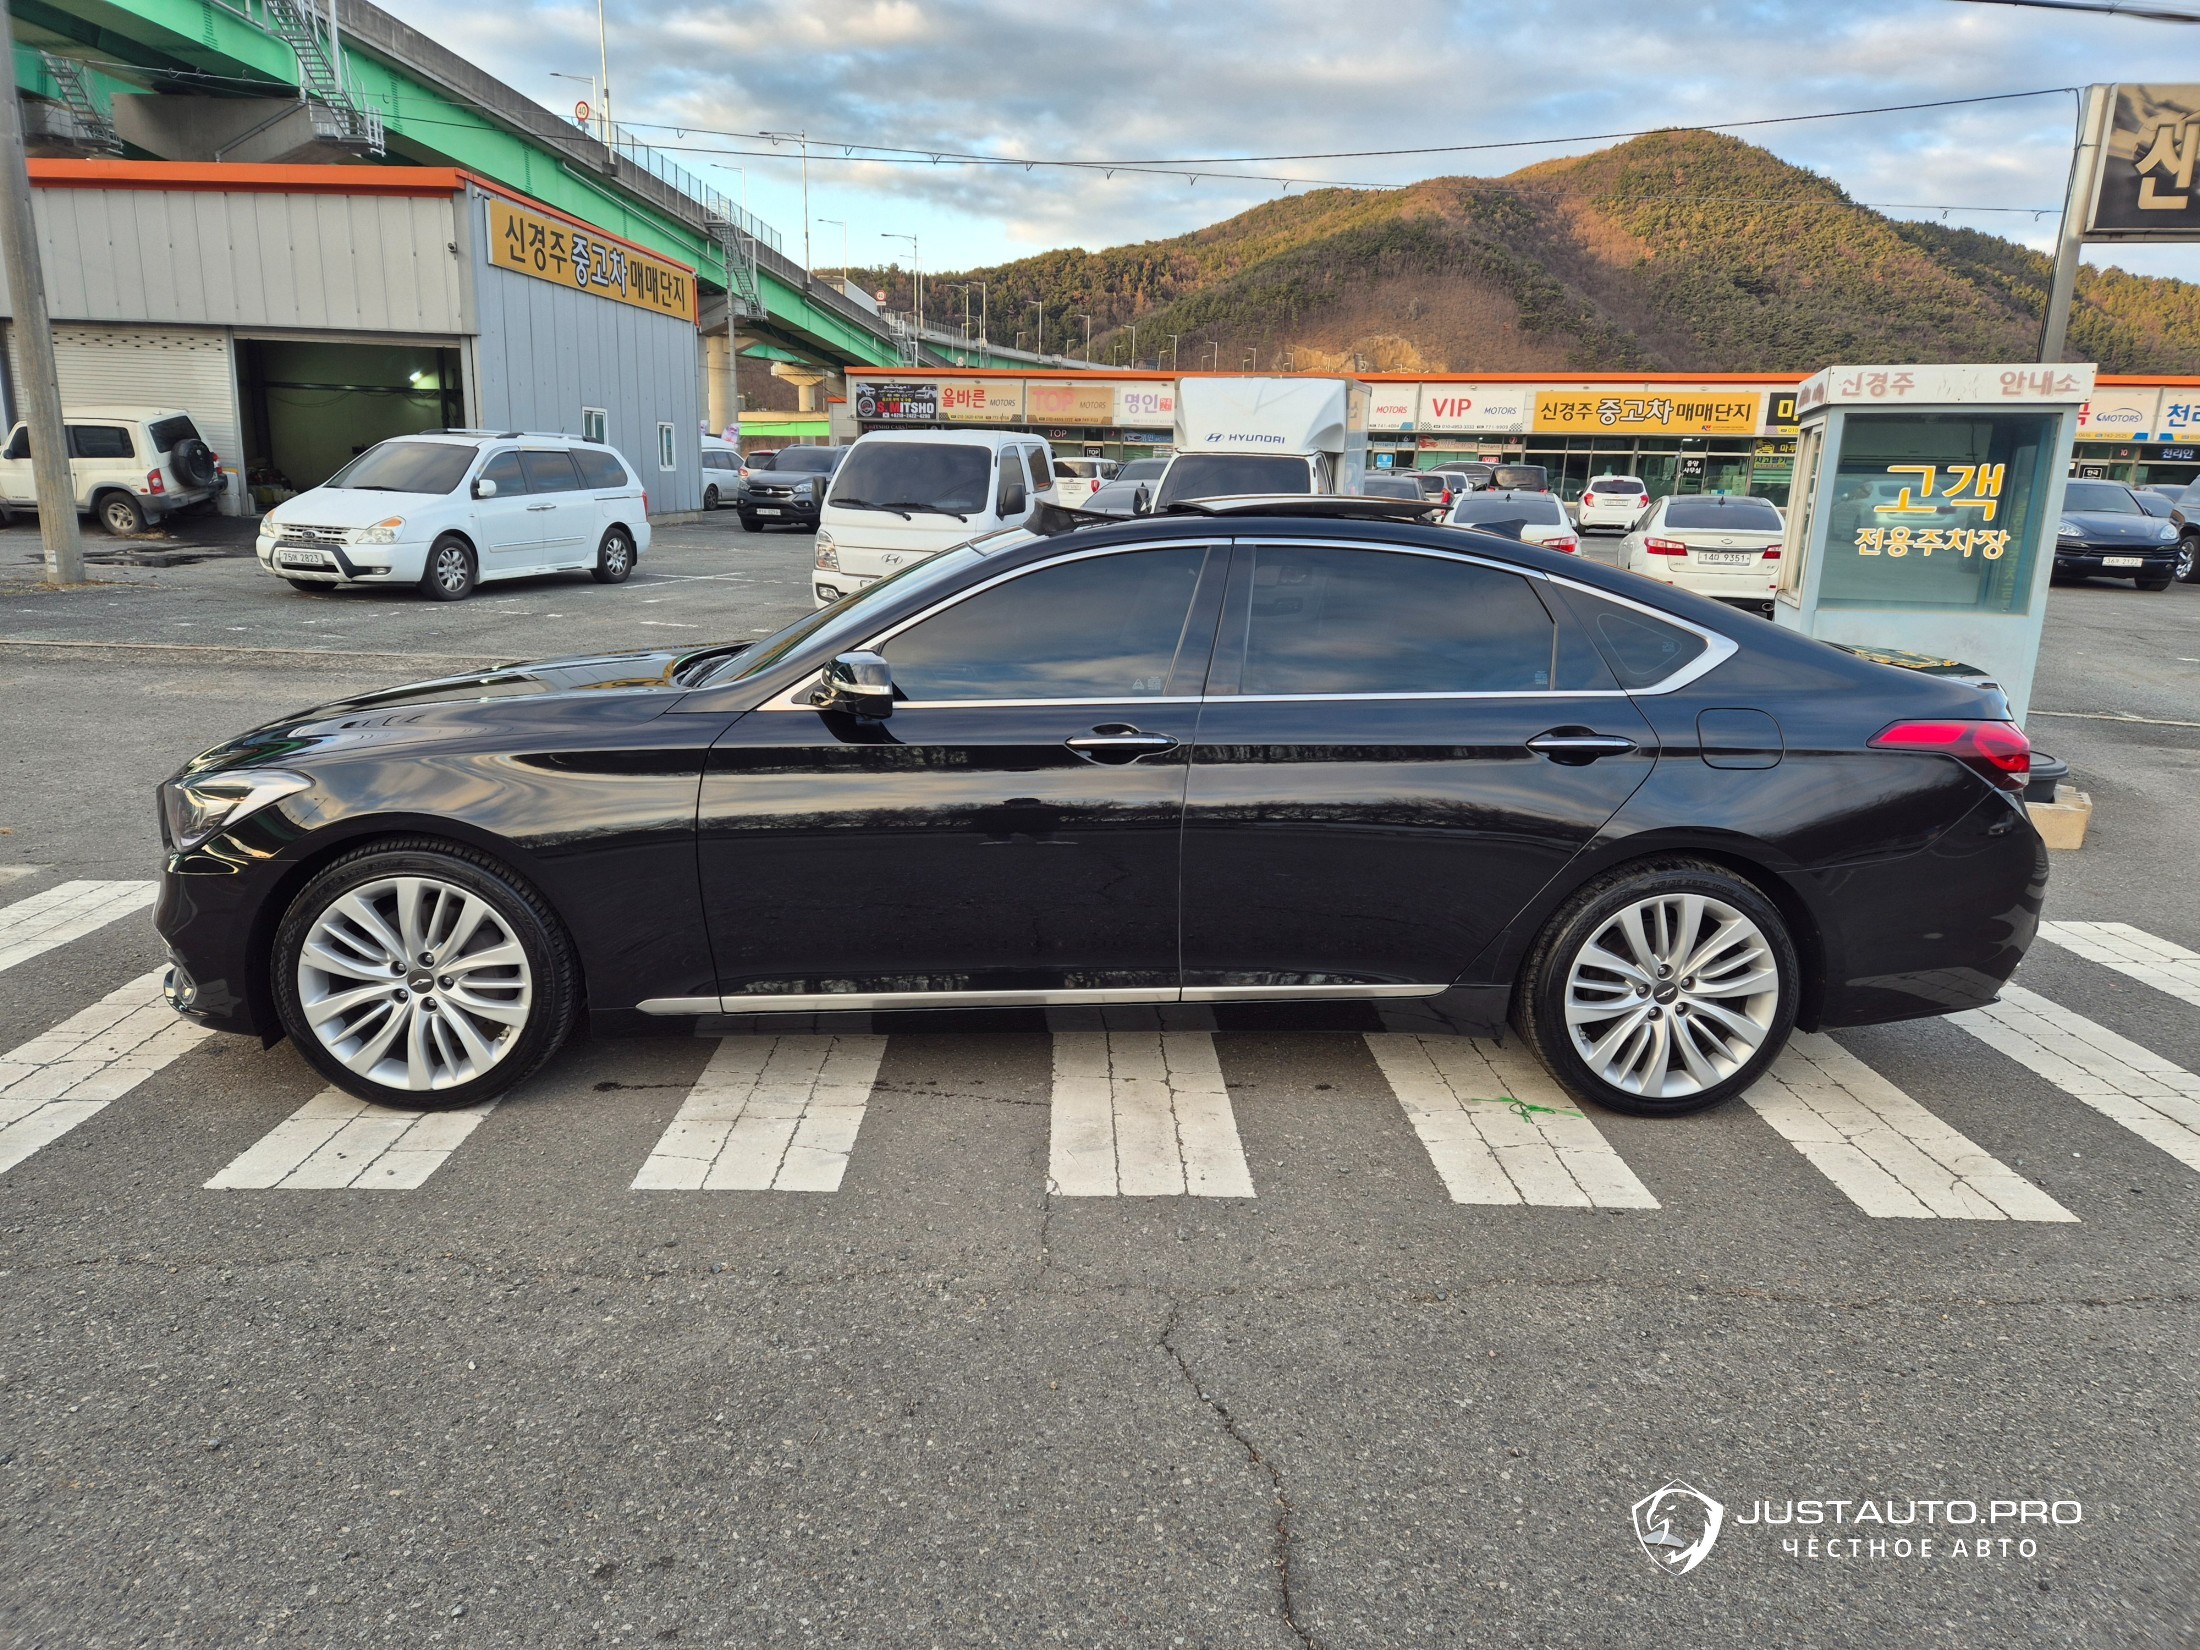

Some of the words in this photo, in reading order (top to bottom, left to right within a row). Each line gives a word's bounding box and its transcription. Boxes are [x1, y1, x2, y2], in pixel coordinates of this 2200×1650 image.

[578, 106, 587, 116] 40
[505, 214, 568, 274] 신경주
[570, 232, 628, 298] 중고차
[630, 260, 686, 312] 매매단지
[1840, 371, 1916, 397] 신경주
[2000, 371, 2081, 396] 안내소
[941, 388, 986, 408] 올바른
[989, 399, 1016, 407] MOTORS
[1032, 390, 1077, 412] TOP
[1124, 393, 1159, 414] 명인
[1079, 401, 1107, 409] MOTORS
[1375, 406, 1408, 414] MOTORS
[1432, 398, 1472, 417] VIP
[1483, 407, 1518, 415] MOTORS
[1540, 402, 1594, 422] 신경주
[1595, 398, 1675, 425] 중고차
[1675, 402, 1752, 422] 매매단지
[2101, 414, 2140, 423] MOTORS
[1049, 429, 1068, 438] TOP
[1228, 433, 1286, 444] HYUNDAI
[2162, 447, 2195, 459] 천리안
[1873, 463, 2006, 522] 고객
[1854, 525, 2012, 560] 전용주차장
[299, 553, 319, 563] 2823
[1723, 554, 1746, 562] 9351
